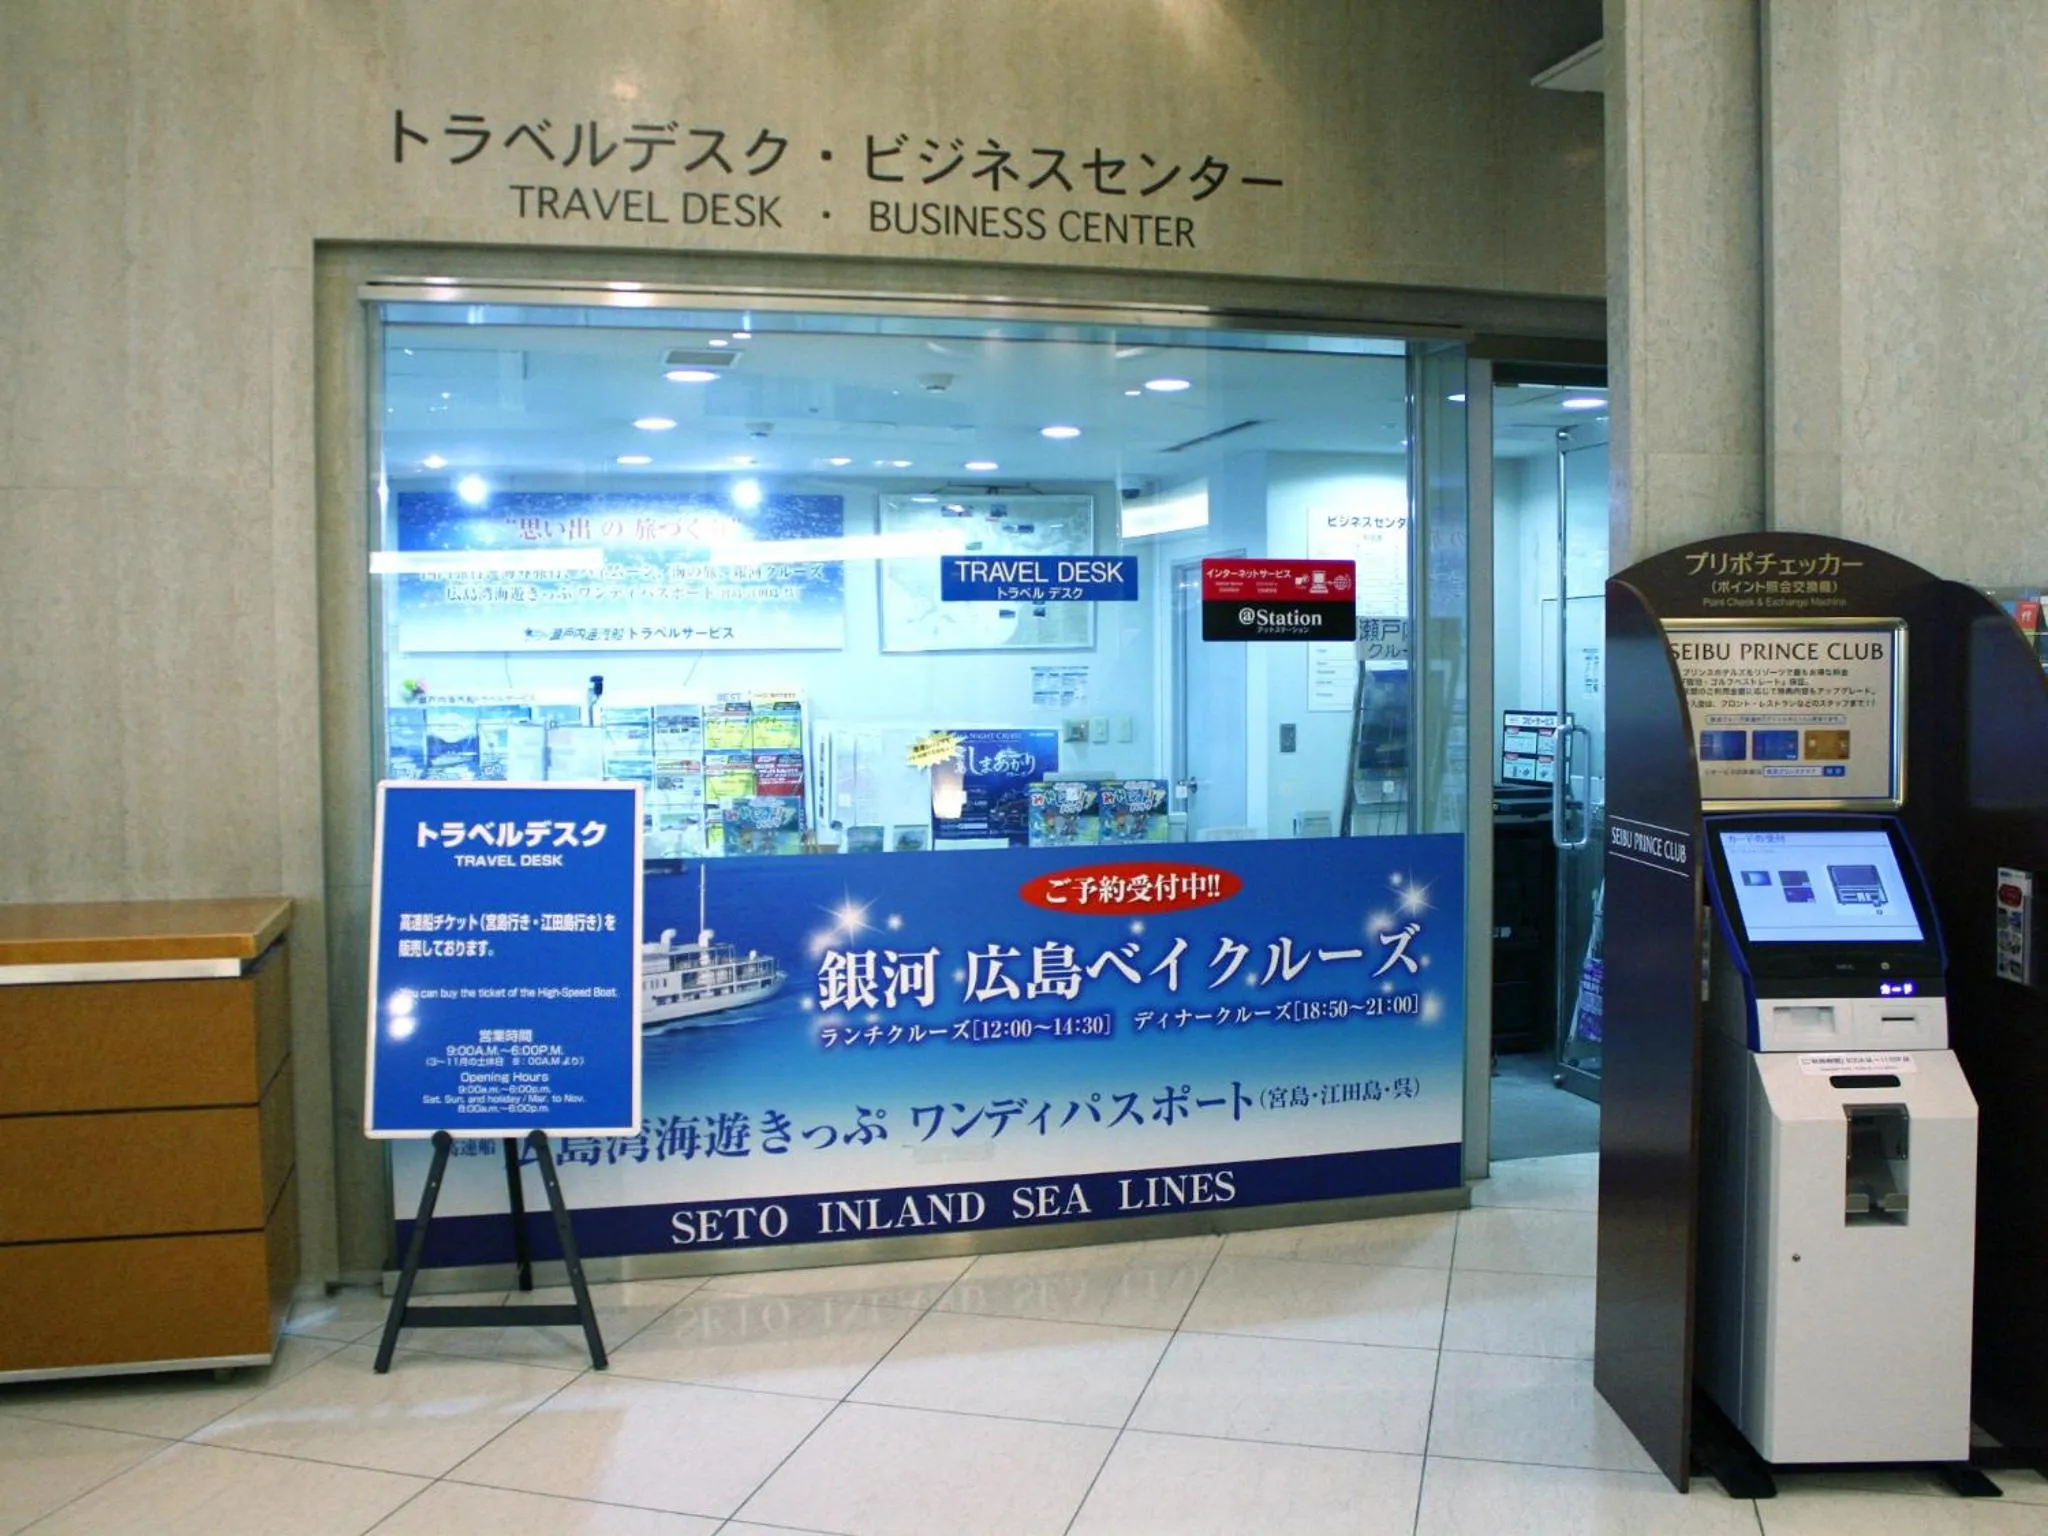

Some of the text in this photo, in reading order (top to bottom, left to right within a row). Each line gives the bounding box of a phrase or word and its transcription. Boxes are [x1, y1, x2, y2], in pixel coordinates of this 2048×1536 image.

[510, 184, 668, 225] TRAVEL
[682, 190, 783, 228] DESK
[869, 202, 1048, 242] BUSINESS
[1058, 209, 1196, 248] CENTER
[954, 560, 1125, 584] TRAVEL DESK
[1206, 568, 1292, 579] インターネットサービス
[1685, 551, 1864, 576] プリポチェッカー
[997, 586, 1084, 600] トラベル デスク
[1239, 606, 1322, 628] @Station
[1671, 642, 1884, 660] SEIBU PRINCE CLUB
[416, 820, 608, 848] トラベルデスク
[1611, 826, 1687, 865] SEIBU PRINCE CLUB
[454, 854, 563, 867] TRAVEL DESK
[817, 921, 1422, 1011] 銀河 広島ベイクルーズ
[420, 990, 438, 998] can
[440, 989, 458, 1001] buy
[460, 989, 477, 998] the
[479, 988, 505, 998] ticket
[507, 988, 517, 998] of
[520, 988, 535, 998] the
[537, 987, 592, 1001] High-Speed
[479, 1029, 533, 1042] 営業時間
[460, 1072, 549, 1084] Opening Hours
[507, 1105, 889, 1168] 島湾海遊きっぷ
[671, 1170, 1236, 1245] SETO INLAND SEA LINES
